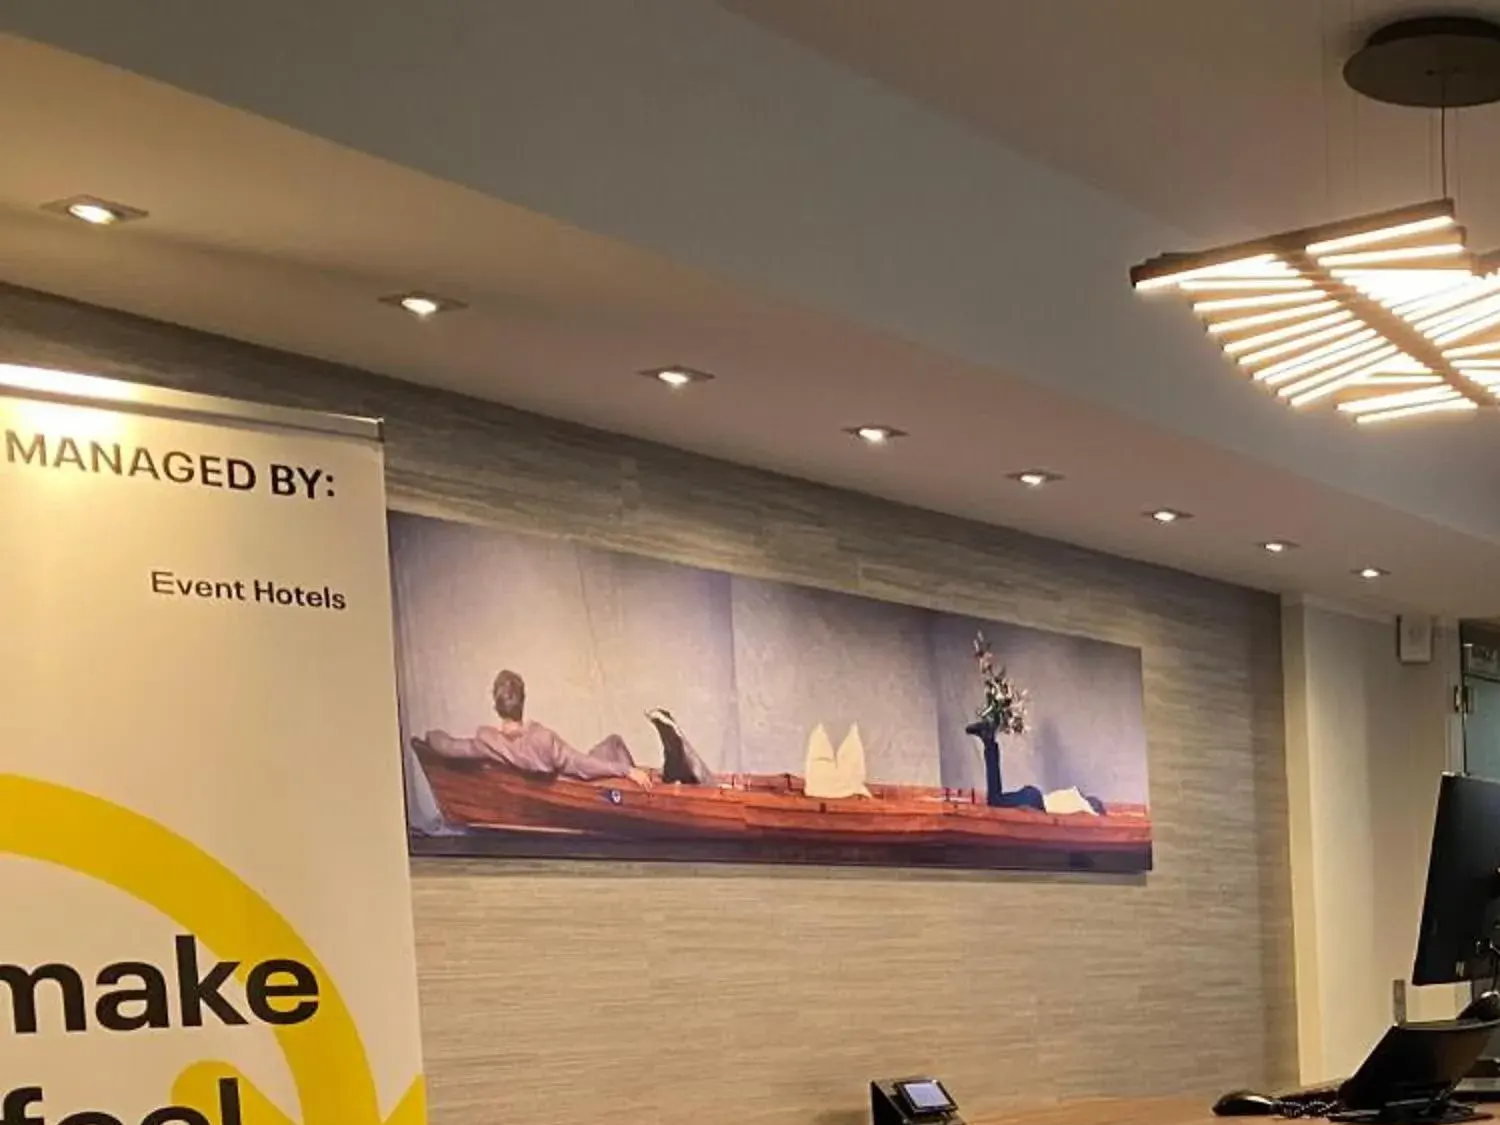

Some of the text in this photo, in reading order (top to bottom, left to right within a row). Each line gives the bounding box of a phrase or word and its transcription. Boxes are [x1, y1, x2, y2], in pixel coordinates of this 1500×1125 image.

[4, 428, 337, 500] MANAGED BY:
[151, 571, 347, 610] Event Hotels
[0, 935, 319, 1034] make
